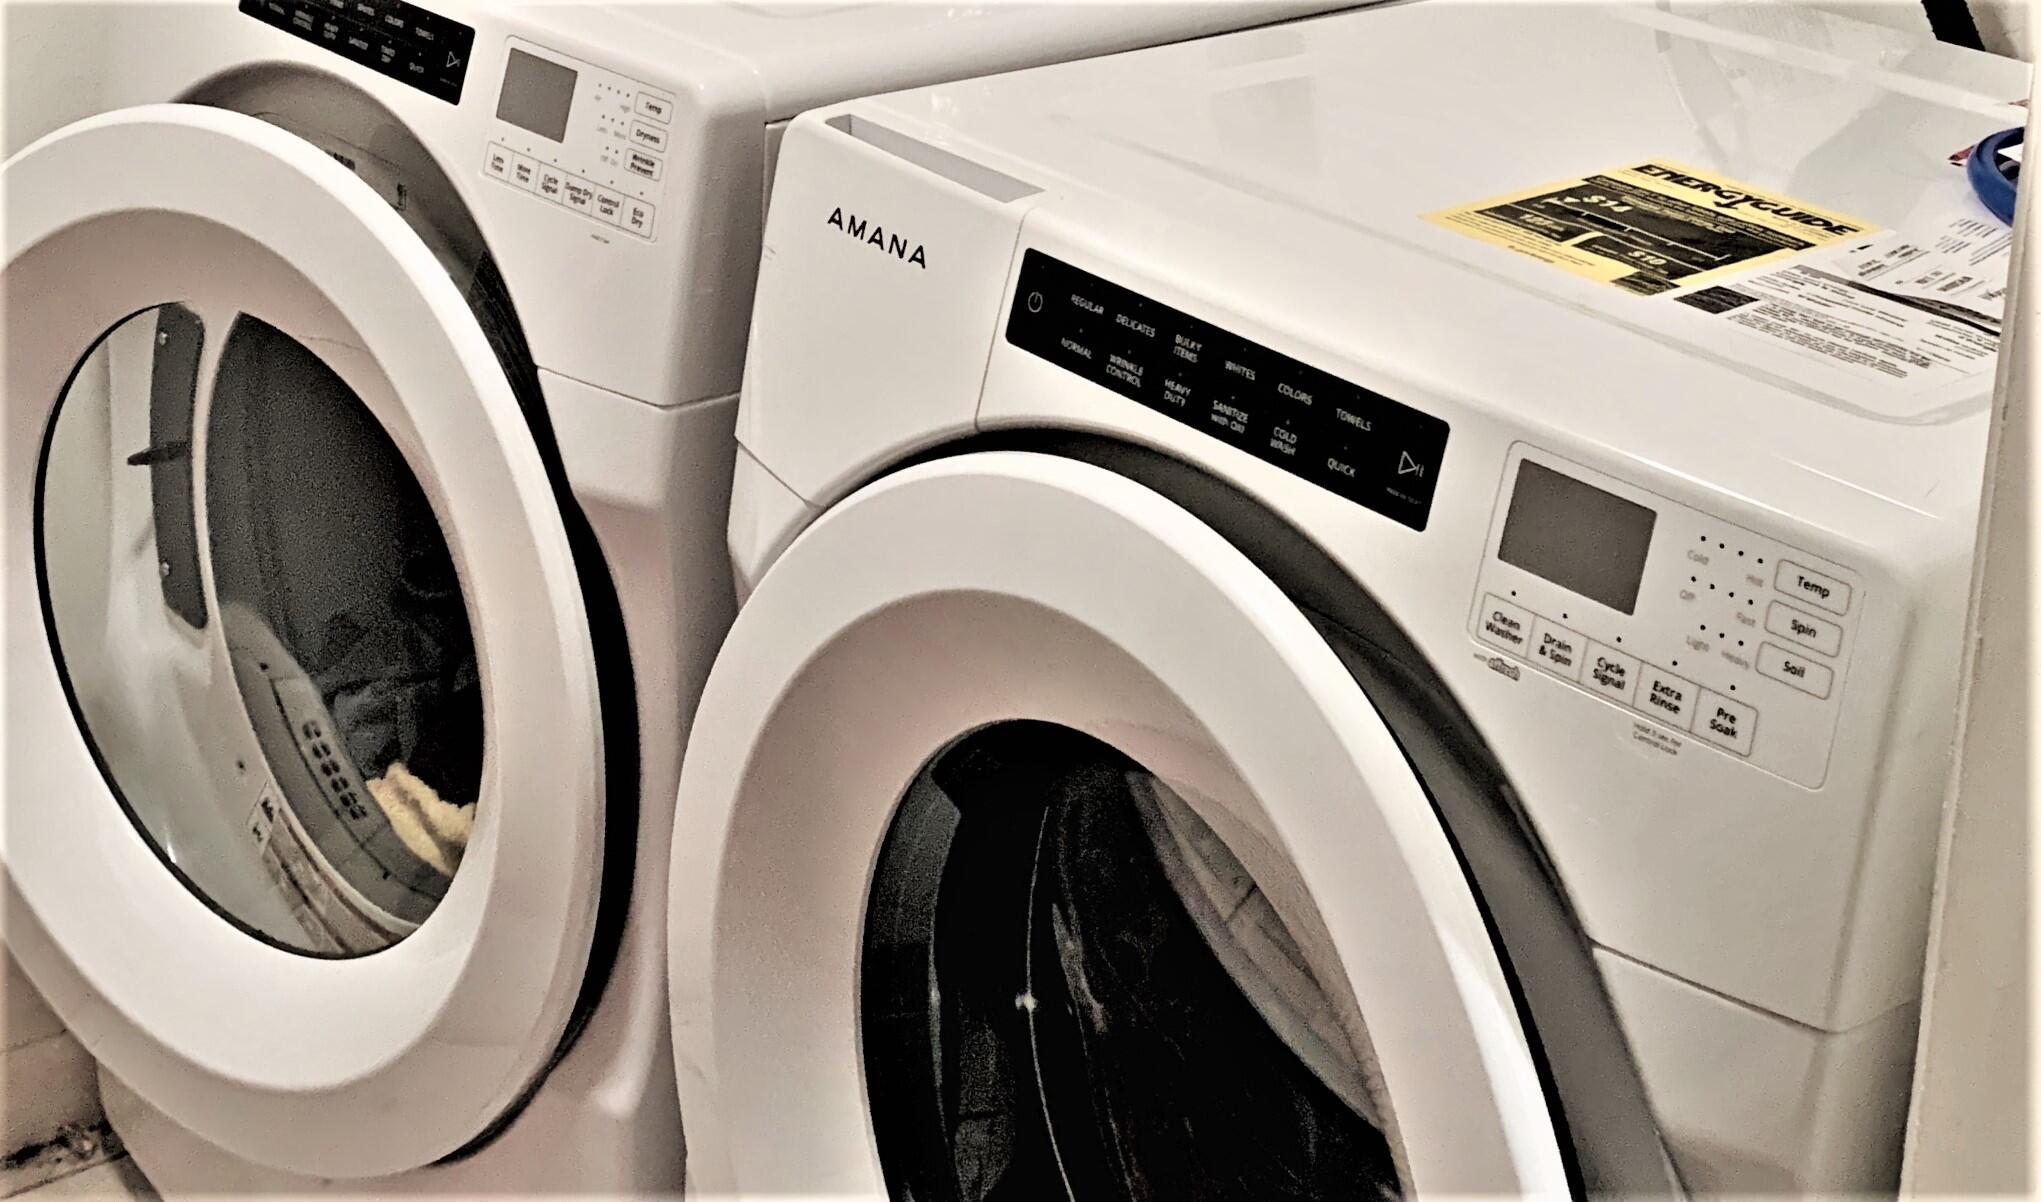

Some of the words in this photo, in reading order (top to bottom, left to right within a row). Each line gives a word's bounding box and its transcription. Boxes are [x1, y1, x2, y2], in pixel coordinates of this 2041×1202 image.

[645, 101, 662, 114] Temp
[636, 128, 660, 144] Dryness
[630, 162, 653, 176] Prevent
[632, 154, 655, 168] Wrinkle
[827, 207, 926, 269] AMANA
[1071, 294, 1104, 315] REGULAR
[1116, 313, 1155, 338] DELICATES
[1061, 337, 1092, 360] NORMAL
[1175, 334, 1202, 352] BULKY
[1173, 345, 1198, 363] ITEMS
[1106, 364, 1142, 388] CONTROL
[1109, 354, 1144, 377] WRINKLE
[1224, 360, 1256, 381] WHITES
[1163, 390, 1186, 407] DUTY
[1164, 379, 1191, 397] HEAVY
[1278, 383, 1313, 406] COLORS
[1212, 400, 1249, 423] SANITIZE
[1336, 408, 1372, 432] TOWELS
[1273, 426, 1297, 444] COLD
[1270, 438, 1296, 456] WASH
[1327, 457, 1356, 478] QUICK
[1796, 575, 1830, 600] Temp
[1492, 611, 1521, 631] Clean
[1790, 619, 1817, 638] Spin
[1485, 620, 1524, 645] Washer
[1543, 632, 1573, 653] Drain
[1549, 650, 1572, 667] Spin
[1597, 657, 1626, 677] Cycle
[1783, 660, 1806, 678] Soil
[1592, 668, 1626, 690] Signal
[1652, 680, 1683, 702] Extra
[1649, 692, 1681, 714] Rinse
[1717, 707, 1737, 724] Pre
[1709, 718, 1738, 739] Soak
